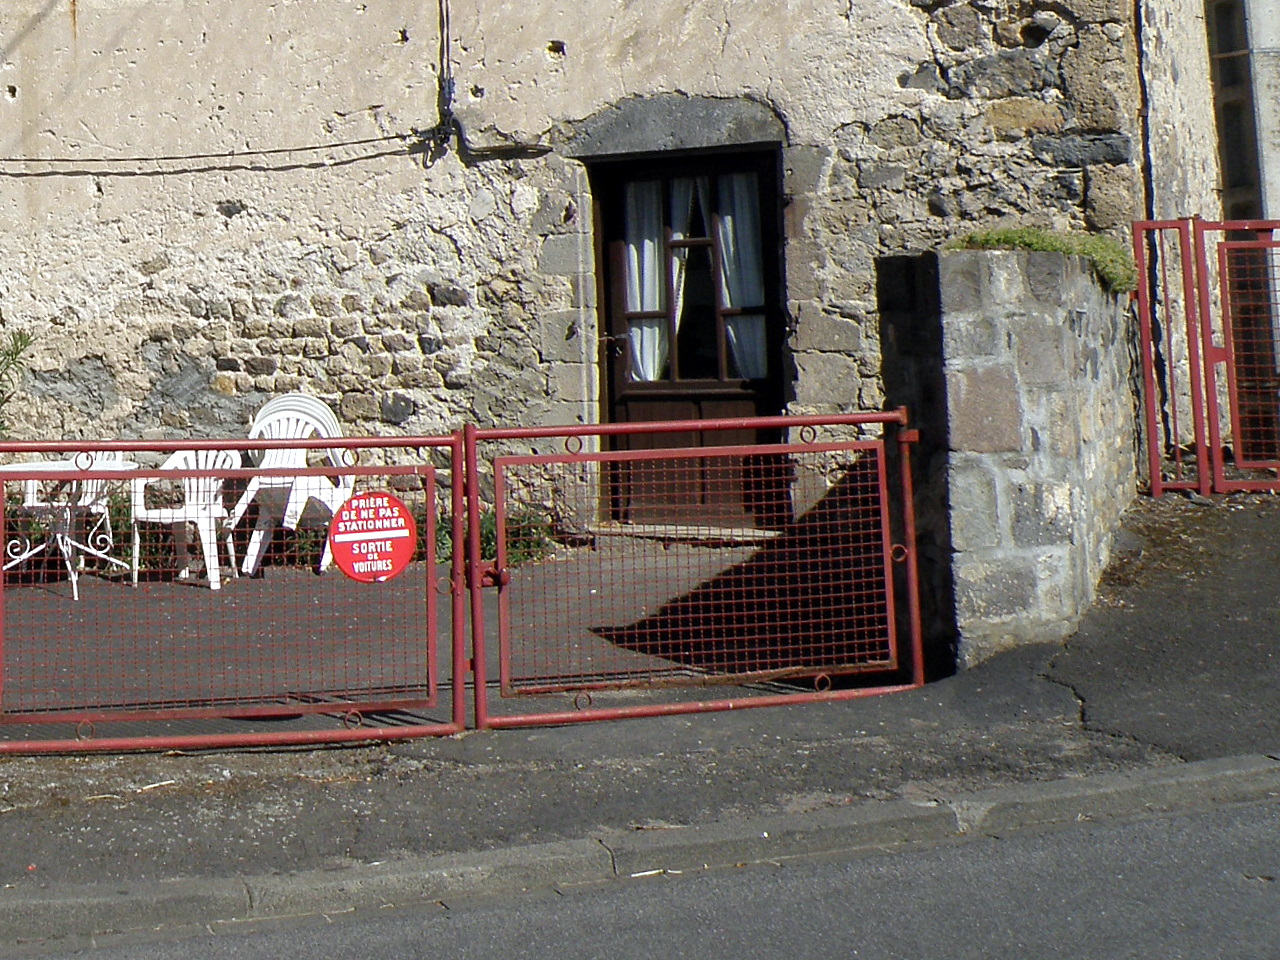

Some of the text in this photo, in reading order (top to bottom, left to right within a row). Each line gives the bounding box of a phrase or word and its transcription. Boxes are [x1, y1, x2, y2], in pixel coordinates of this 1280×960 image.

[351, 497, 389, 509] PRIÈRE
[342, 507, 399, 520] DE NE PAS
[338, 518, 405, 532] STATIONNER
[352, 541, 393, 554] SORTIE
[352, 559, 393, 573] VOITURES
